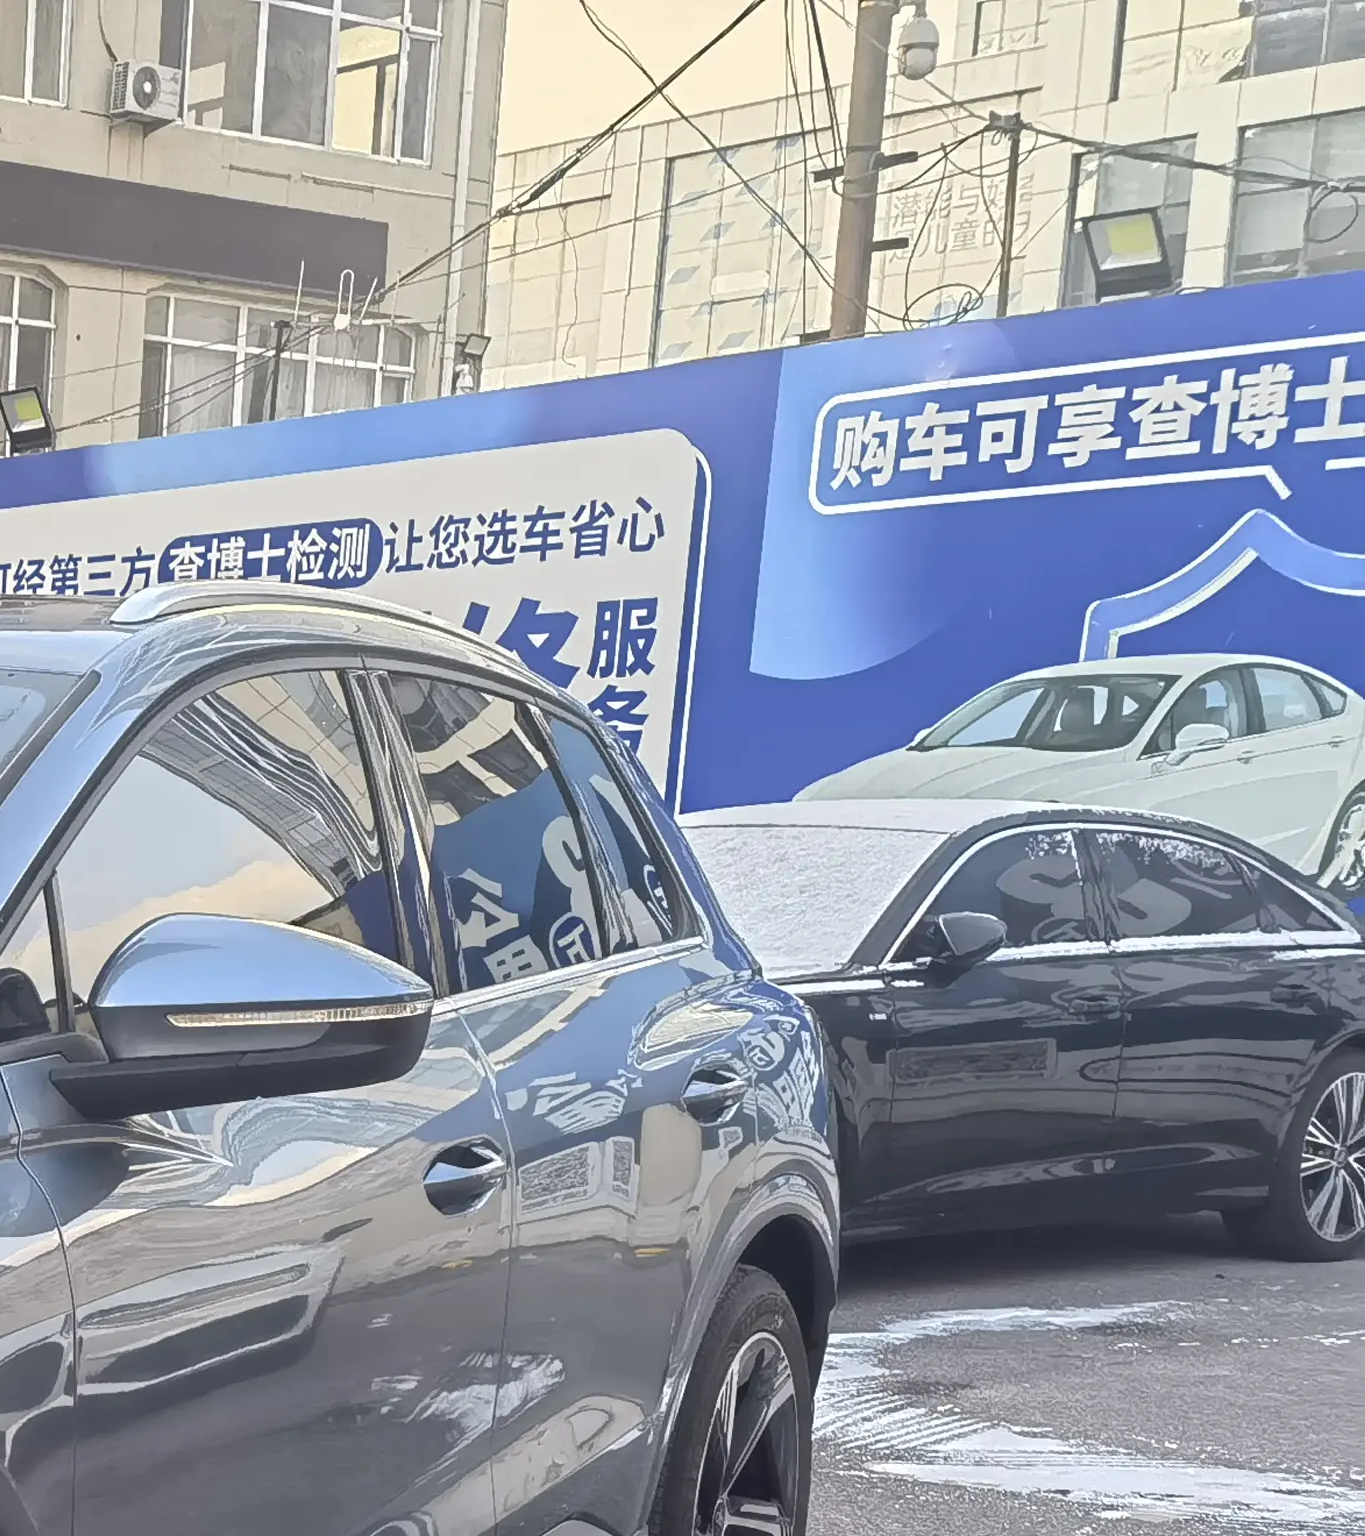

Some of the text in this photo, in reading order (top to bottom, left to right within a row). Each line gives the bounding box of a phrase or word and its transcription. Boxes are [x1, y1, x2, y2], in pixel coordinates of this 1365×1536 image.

[830, 356, 1365, 490] 购车可享查博士
